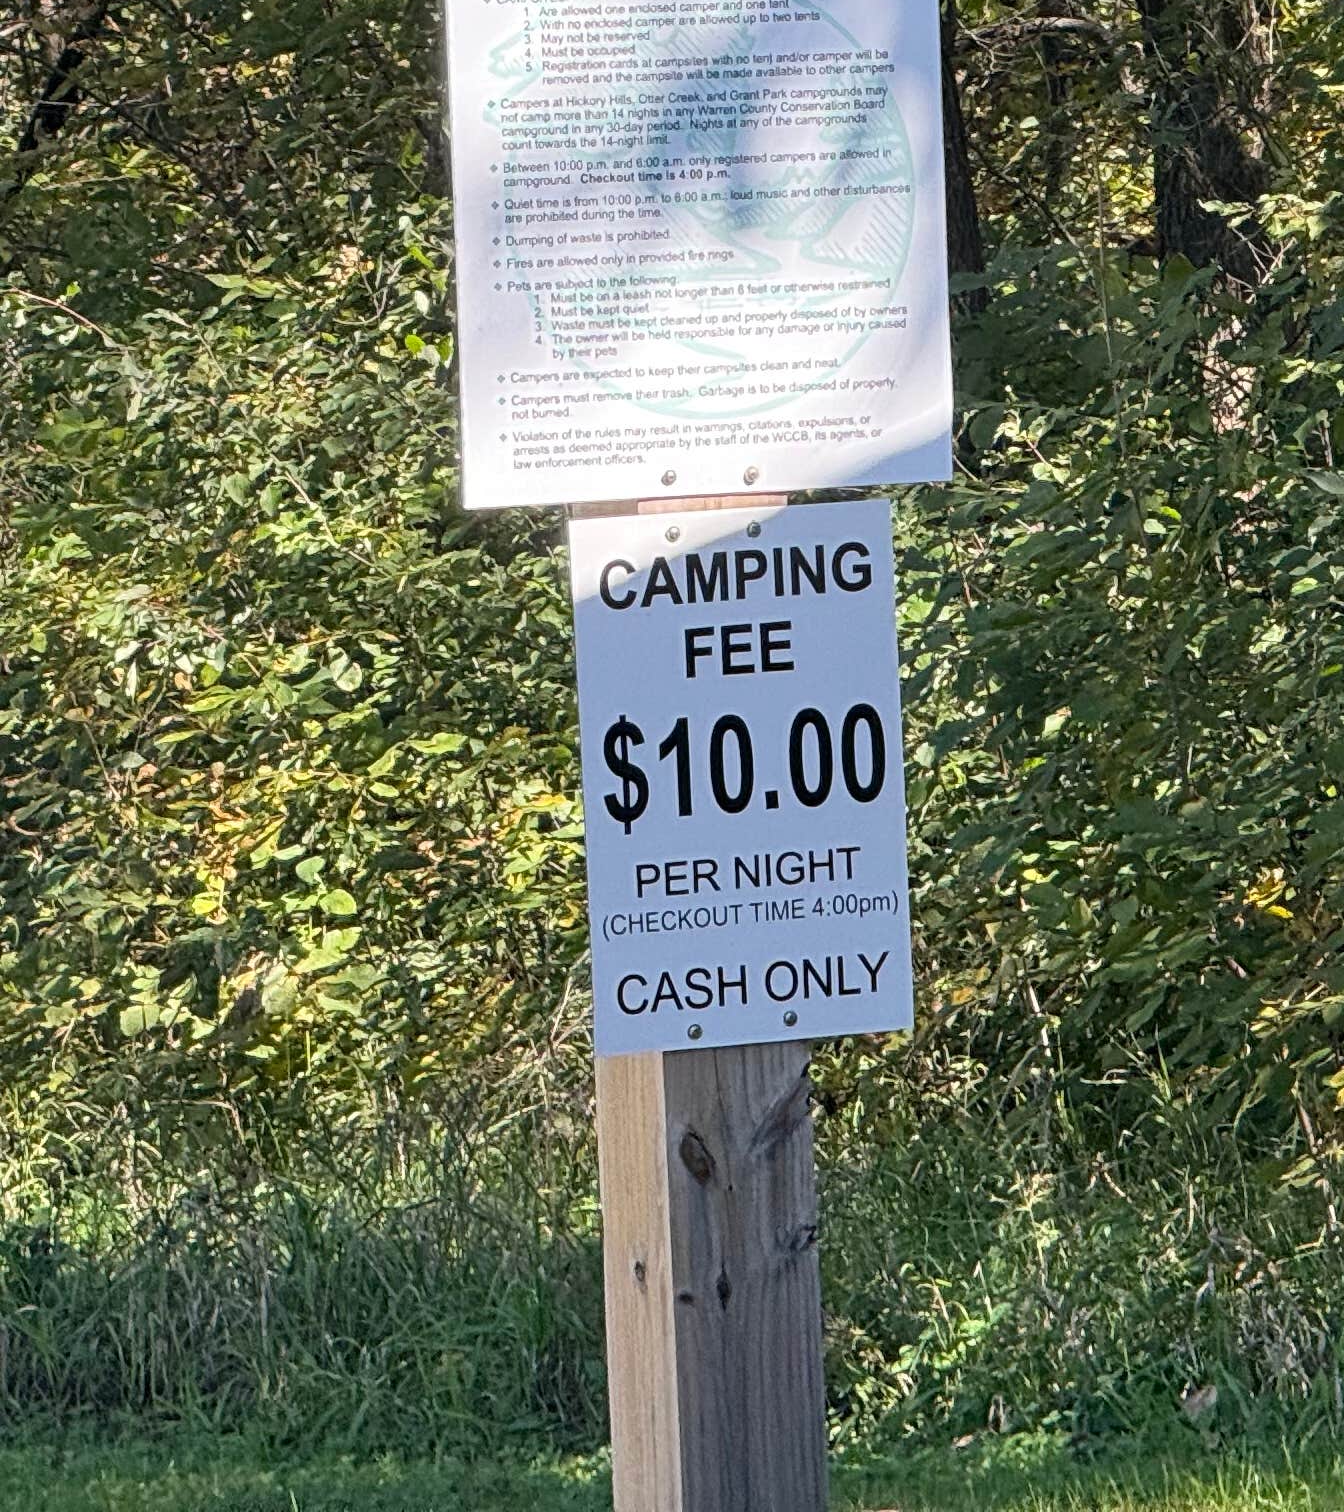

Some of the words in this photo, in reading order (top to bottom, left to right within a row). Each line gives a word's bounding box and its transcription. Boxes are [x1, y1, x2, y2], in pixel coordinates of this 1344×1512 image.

[499, 96, 550, 111] Campers
[552, 96, 562, 107] at
[565, 94, 606, 110] Hickory
[637, 92, 665, 104] Otter
[706, 89, 727, 102] and
[729, 88, 760, 103] Grant
[762, 87, 787, 99] Park
[789, 84, 862, 101] campgrounds
[865, 85, 888, 98] may
[500, 112, 519, 123] not
[520, 112, 551, 124] camp
[553, 111, 581, 121] more
[584, 108, 609, 120] than
[611, 107, 624, 119] 14
[627, 106, 659, 121] nights
[662, 105, 673, 117] in
[675, 105, 695, 119] any
[695, 103, 737, 116] Warren
[738, 101, 778, 116] County
[779, 98, 851, 113] Conservation
[853, 97, 885, 110] Board
[500, 123, 569, 140] campground
[571, 123, 581, 134] in
[584, 124, 604, 136] any
[605, 121, 643, 135] 30-day
[689, 117, 724, 132] Nights
[726, 117, 737, 128] at
[739, 118, 760, 130] any
[761, 115, 773, 127] of
[775, 115, 792, 126] the
[794, 112, 867, 128] campgrounds
[501, 139, 532, 151] count
[534, 136, 577, 149] towards
[579, 136, 597, 148] the
[600, 134, 644, 149] 14-night
[502, 160, 550, 174] Between
[553, 159, 584, 172] 10:00
[586, 160, 609, 172] p.m.
[612, 157, 633, 169] and
[688, 154, 712, 168] only
[713, 152, 767, 167] registered
[769, 152, 816, 165] campers
[818, 151, 836, 161] are
[838, 147, 879, 160] allowed
[882, 146, 891, 159] in
[579, 170, 635, 184] Checkout
[637, 170, 663, 182] time
[665, 169, 675, 180] is
[678, 168, 703, 180] 4:00
[706, 169, 731, 181] p.m.
[503, 197, 534, 210] Quiet
[535, 197, 559, 209] time
[562, 198, 572, 208] is
[572, 194, 598, 207] from
[601, 193, 632, 206] 10:00
[634, 194, 658, 206] p.m.
[659, 193, 672, 203] to
[729, 188, 753, 201] loud
[755, 189, 788, 199] music
[790, 186, 810, 198] and
[812, 185, 841, 197] other
[843, 181, 911, 196] disturbances
[504, 214, 522, 224] are
[525, 209, 578, 225] prohibited
[581, 208, 615, 222] during
[617, 207, 635, 219] the
[505, 233, 554, 249] Dumping
[556, 232, 568, 244] of
[569, 232, 601, 243] waste
[604, 230, 614, 241] is
[506, 256, 534, 270] Fires
[536, 258, 554, 268] are
[556, 253, 598, 267] allowed
[599, 252, 624, 268] only
[625, 253, 636, 263] in
[638, 250, 685, 266] provided
[687, 248, 705, 262] fire
[509, 370, 560, 385] Campers
[562, 371, 581, 381] are
[582, 367, 632, 382] expected
[634, 367, 646, 377] to
[648, 366, 674, 379] keep
[676, 364, 701, 375] their
[703, 361, 757, 376] campsites
[759, 359, 788, 371] clean
[791, 357, 812, 369] and
[600, 541, 873, 610] CAMPING
[684, 620, 795, 678] FEE
[603, 703, 887, 835] $10.00
[636, 859, 721, 898] PER
[735, 847, 861, 888] NIGHT
[602, 903, 744, 942] (CHECKOUT
[749, 899, 806, 923] TIME
[812, 890, 899, 920] 4:00pm)
[617, 964, 748, 1016] CASH
[765, 951, 889, 1002] ONLY
